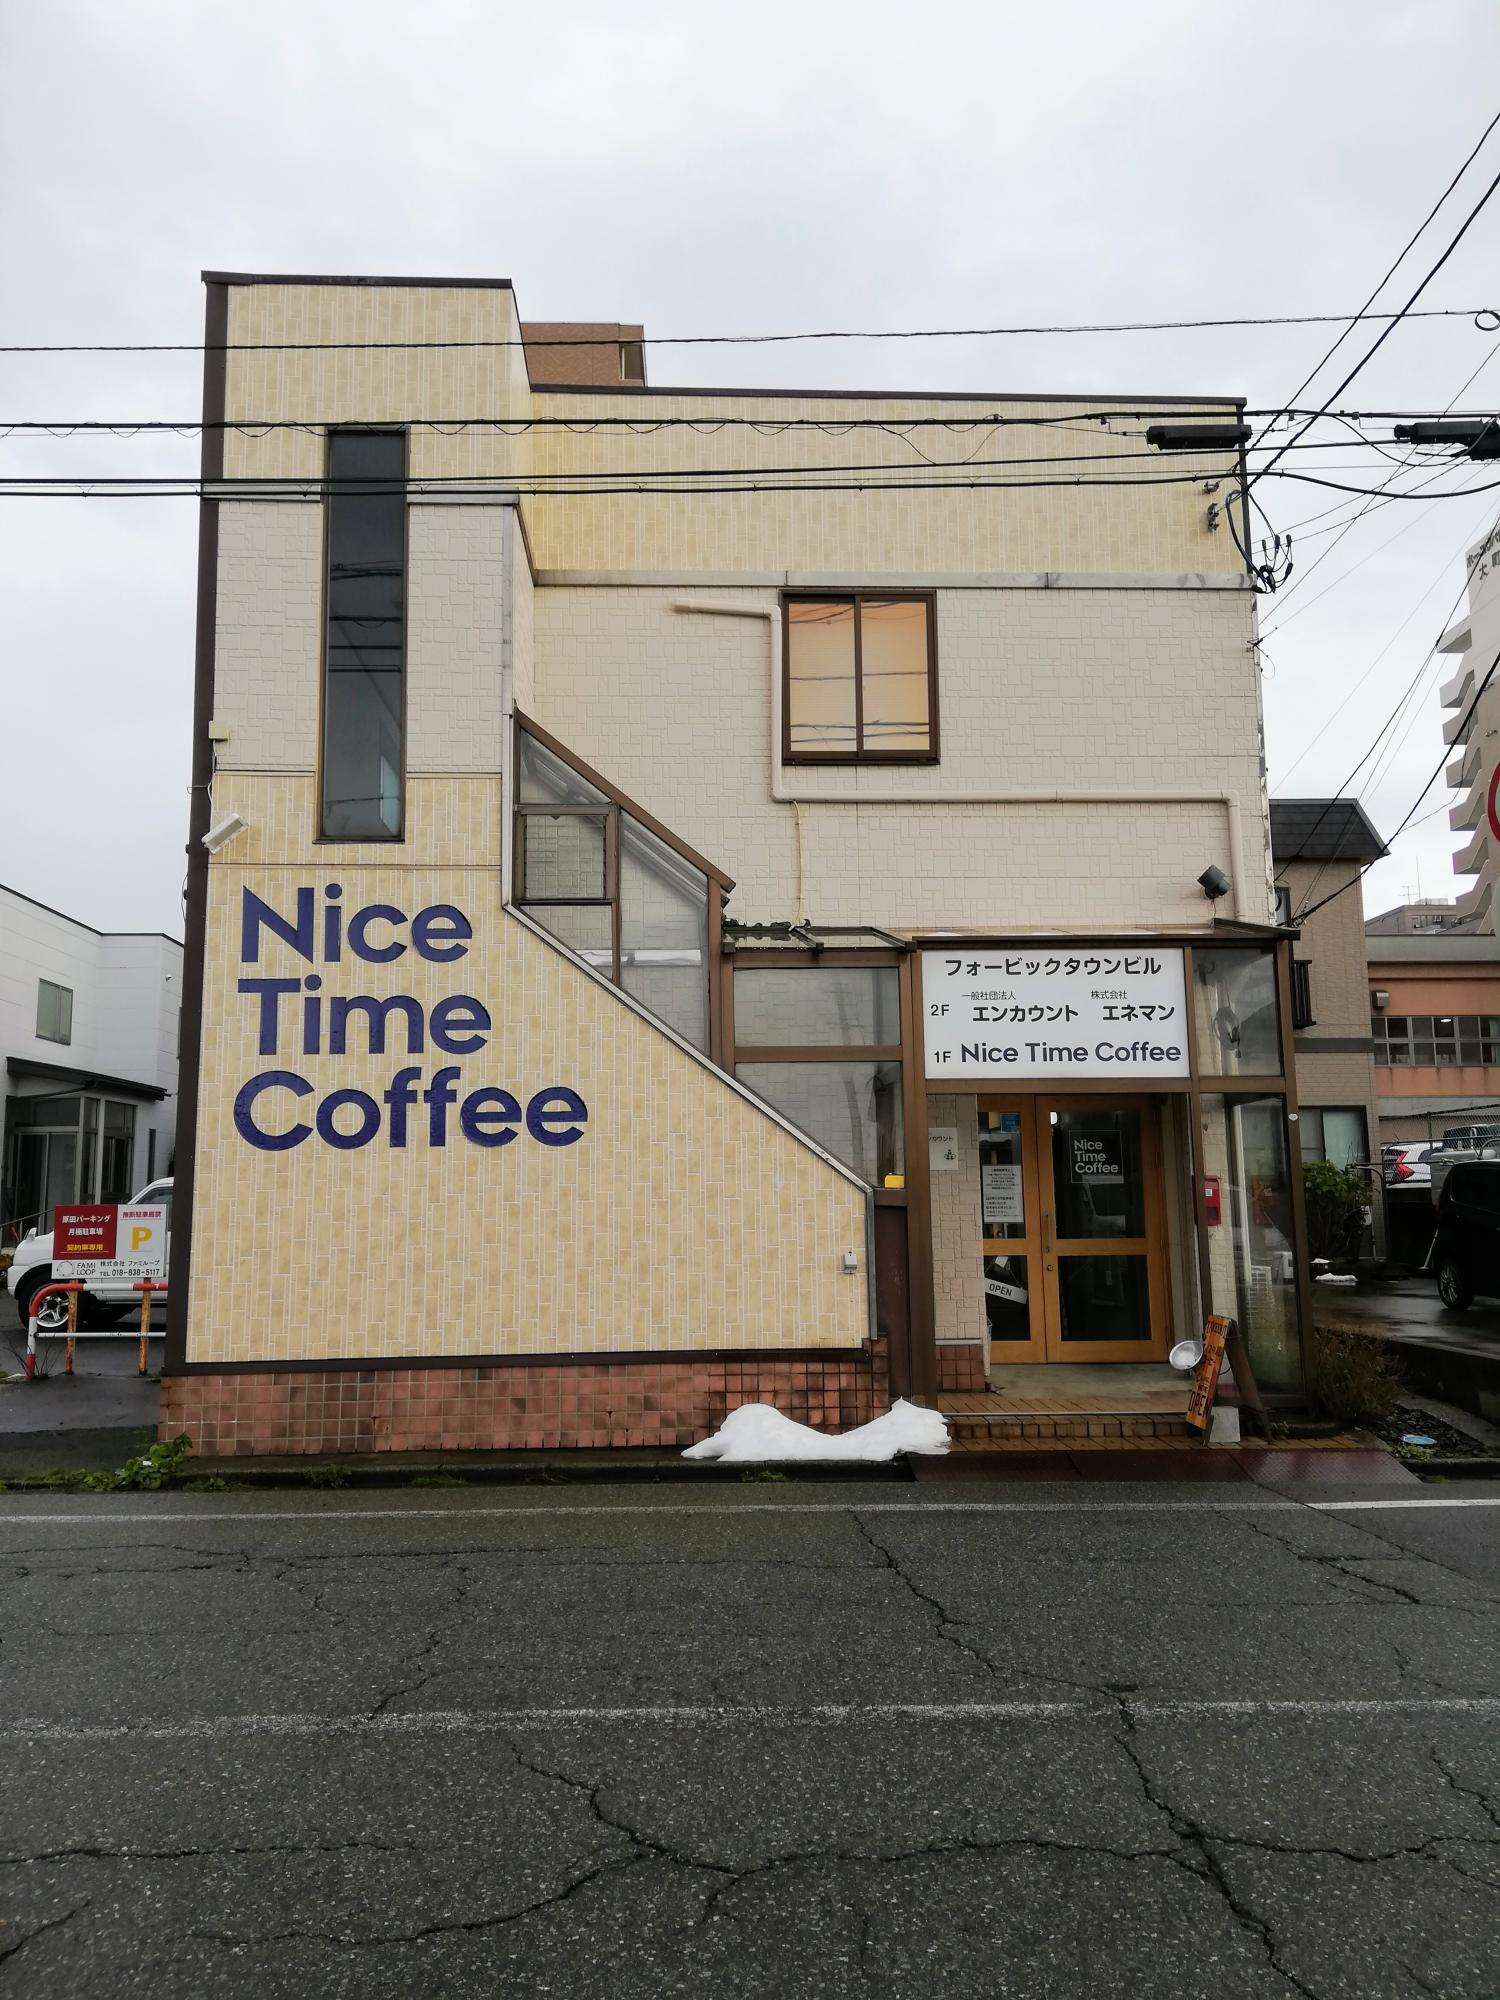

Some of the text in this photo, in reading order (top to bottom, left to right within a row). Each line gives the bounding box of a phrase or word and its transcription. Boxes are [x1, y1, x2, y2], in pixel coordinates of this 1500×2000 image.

[241, 882, 473, 964] Nice
[945, 957, 1162, 976] フォービックタウンビル
[961, 990, 1128, 1001] 一般社団法人 株式会社
[237, 974, 492, 1056] Time
[931, 1004, 1175, 1022] 2F エンカウント エネマン
[934, 1041, 1181, 1063] 1F Nice Time Coffee
[233, 1066, 588, 1151] Coffee
[1073, 1139, 1103, 1150] Nice
[1074, 1151, 1107, 1162] Time
[1075, 1162, 1119, 1173] Coffee
[131, 1226, 153, 1250] P
[989, 1283, 1013, 1297] OPEN
